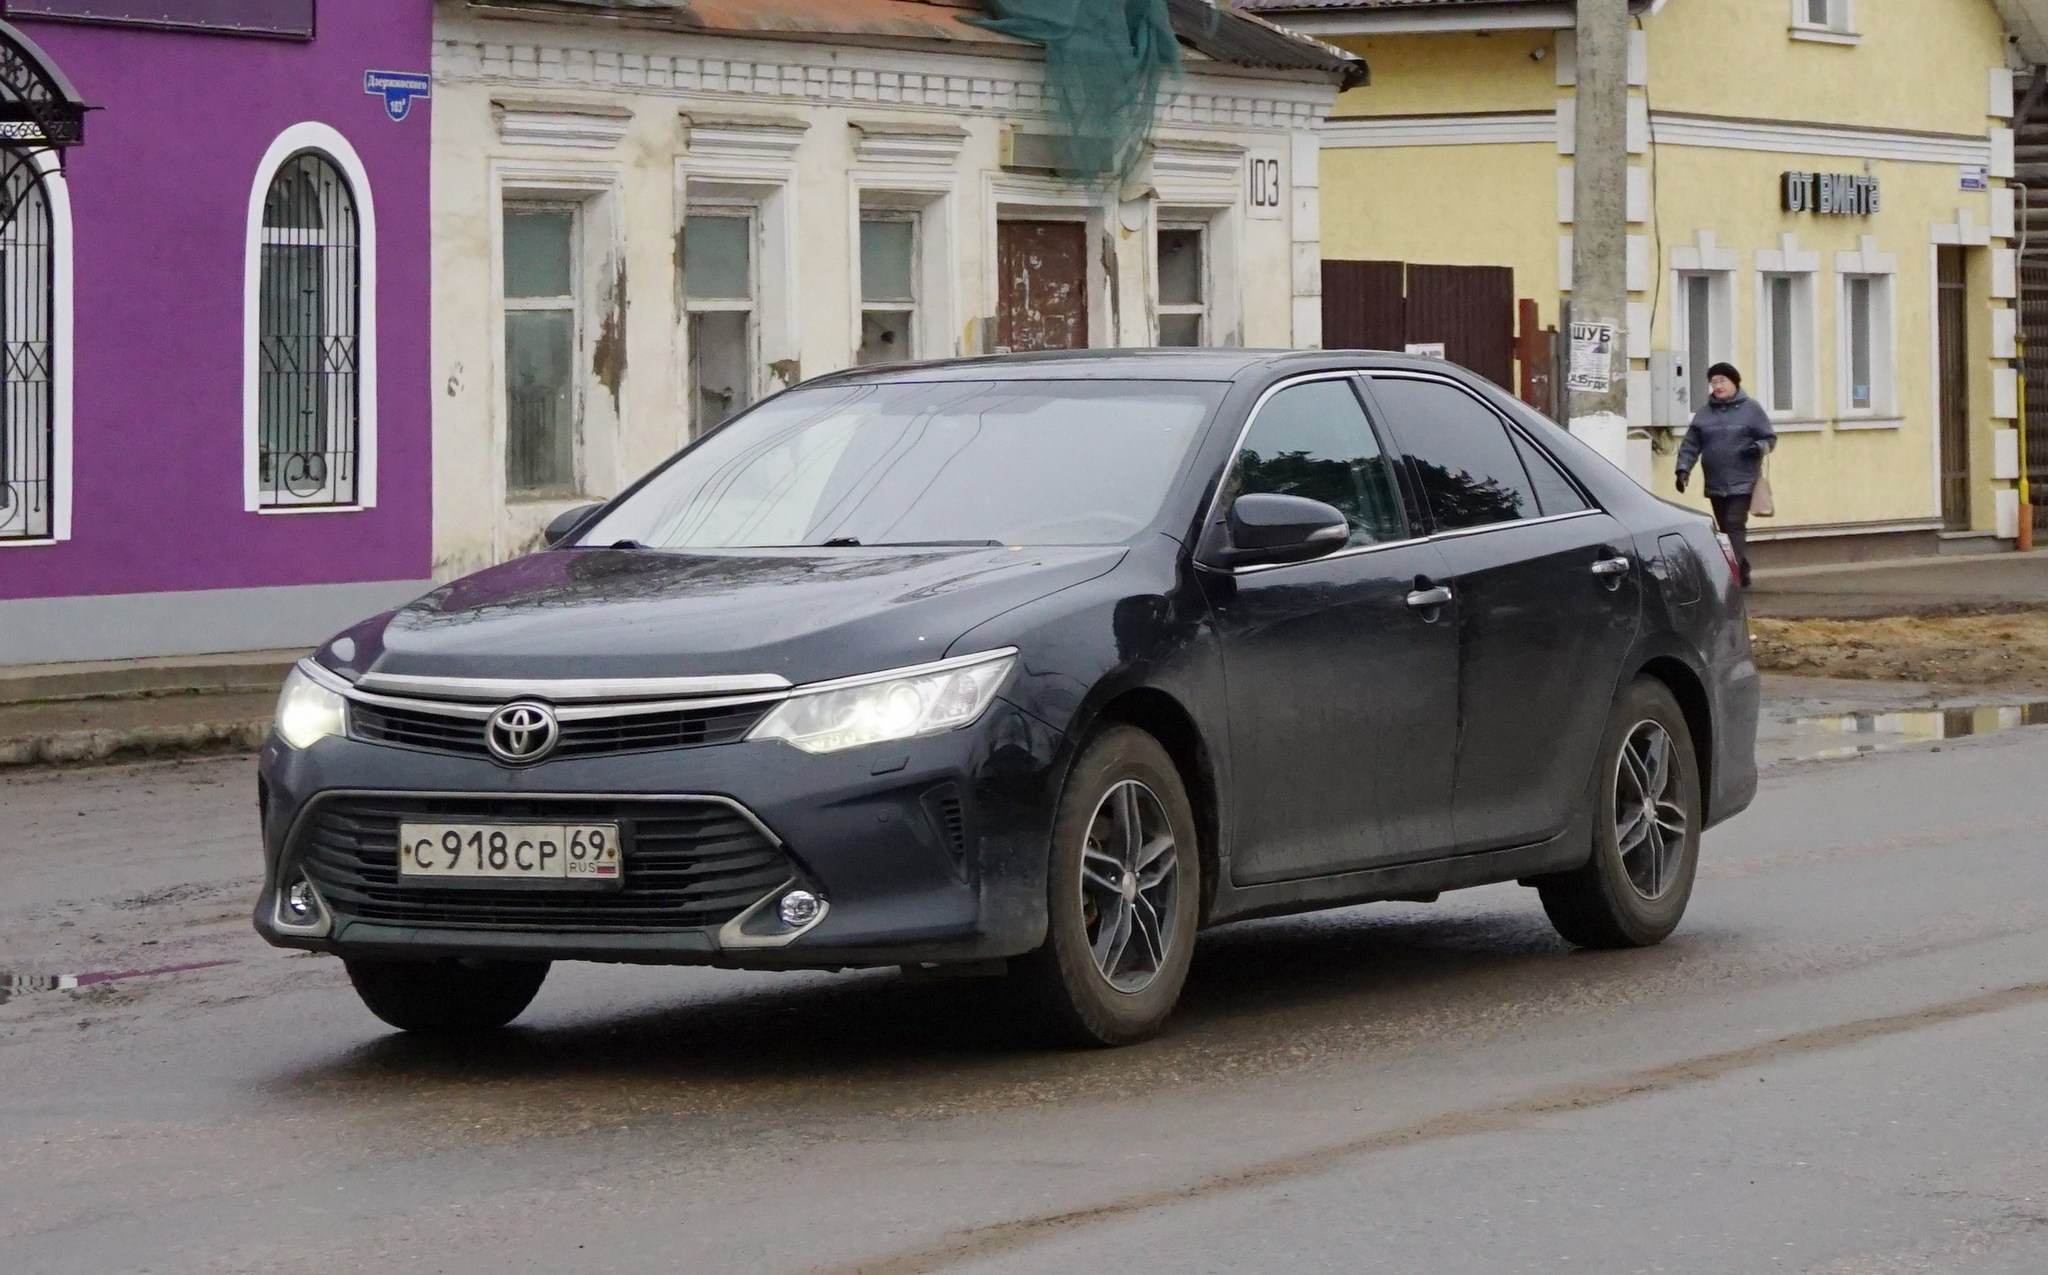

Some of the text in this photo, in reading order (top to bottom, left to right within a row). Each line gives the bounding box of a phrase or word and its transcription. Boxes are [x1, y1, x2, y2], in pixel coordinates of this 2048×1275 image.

[1250, 157, 1279, 207] 103
[1787, 171, 1814, 212] ОТ
[1573, 326, 1611, 342] ШУБ
[569, 862, 596, 873] RUS
